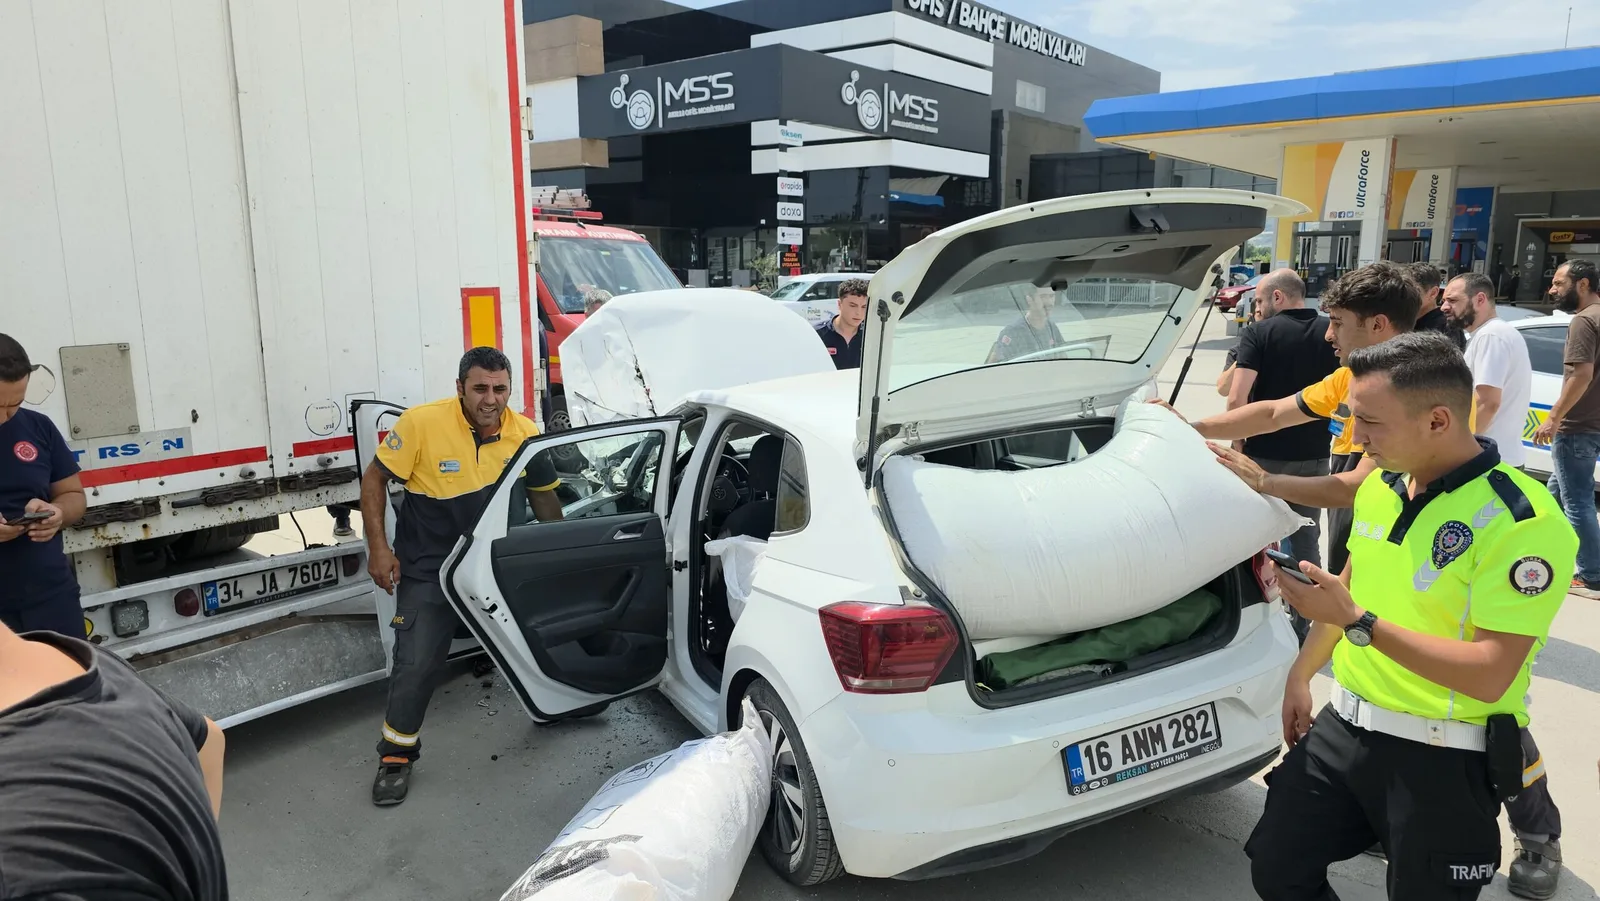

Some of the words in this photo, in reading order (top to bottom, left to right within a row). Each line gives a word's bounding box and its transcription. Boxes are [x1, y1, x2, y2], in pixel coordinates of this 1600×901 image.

[959, 2, 1006, 42] BAHÇE
[1009, 21, 1087, 66] MOBİLYALARI
[780, 206, 802, 217] doxa
[219, 580, 243, 604] 34
[256, 571, 279, 596] JA
[288, 559, 334, 588] 7602
[208, 596, 218, 605] TR
[1084, 740, 1113, 776] 16
[1121, 723, 1167, 765] ANM
[1168, 710, 1212, 748] 282
[1071, 767, 1083, 778] TR
[1116, 764, 1148, 781] REKSAN
[1160, 755, 1175, 767] YEDEK
[1174, 751, 1189, 762] PARÇA
